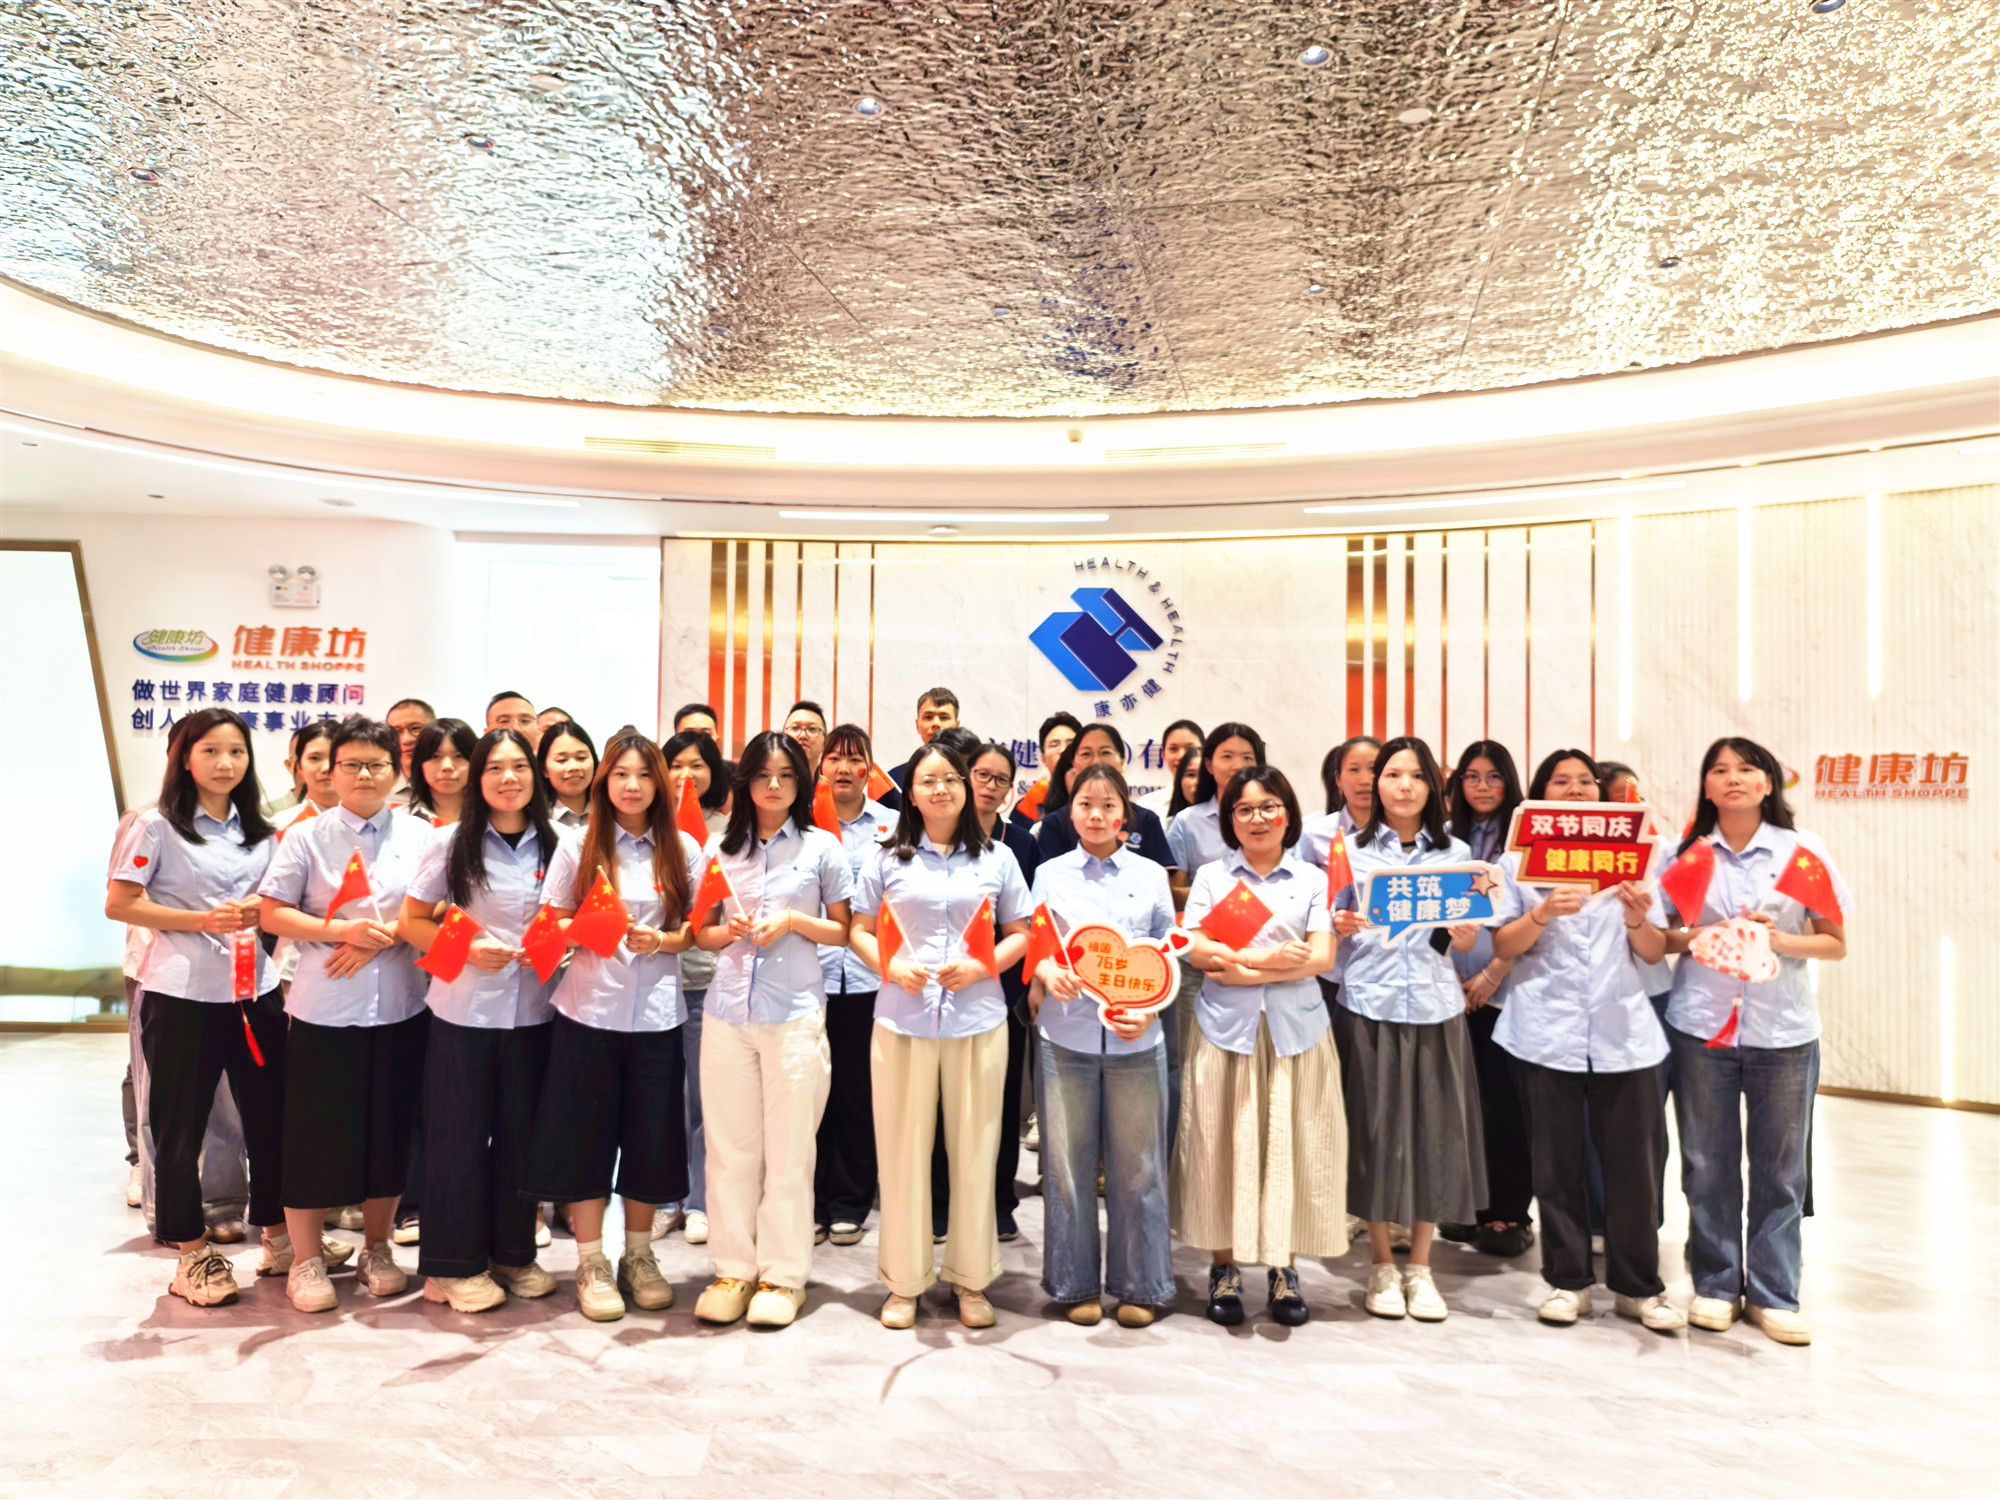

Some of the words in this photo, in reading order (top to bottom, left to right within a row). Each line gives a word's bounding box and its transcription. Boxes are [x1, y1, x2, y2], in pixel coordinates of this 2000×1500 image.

[1073, 556, 1149, 580] HEALTH
[1148, 581, 1162, 593] &
[1160, 597, 1184, 675] HEALTH
[231, 624, 367, 658] 健康坊
[231, 660, 296, 671] HEALTH
[300, 661, 366, 673] SHOPPE
[132, 679, 365, 705] 做世界家庭健康顾问
[1093, 678, 1162, 719] 康亦健
[1815, 752, 1969, 785] 健康坊
[1815, 788, 1887, 800] HEALTH
[1892, 788, 1970, 800] SHOPPE
[1530, 814, 1633, 838] 双节同庆
[1545, 848, 1639, 874] 健康同行
[1387, 876, 1442, 898] 共筑
[1386, 898, 1471, 923] 健康梦
[1098, 972, 1157, 992] 生日快乐
